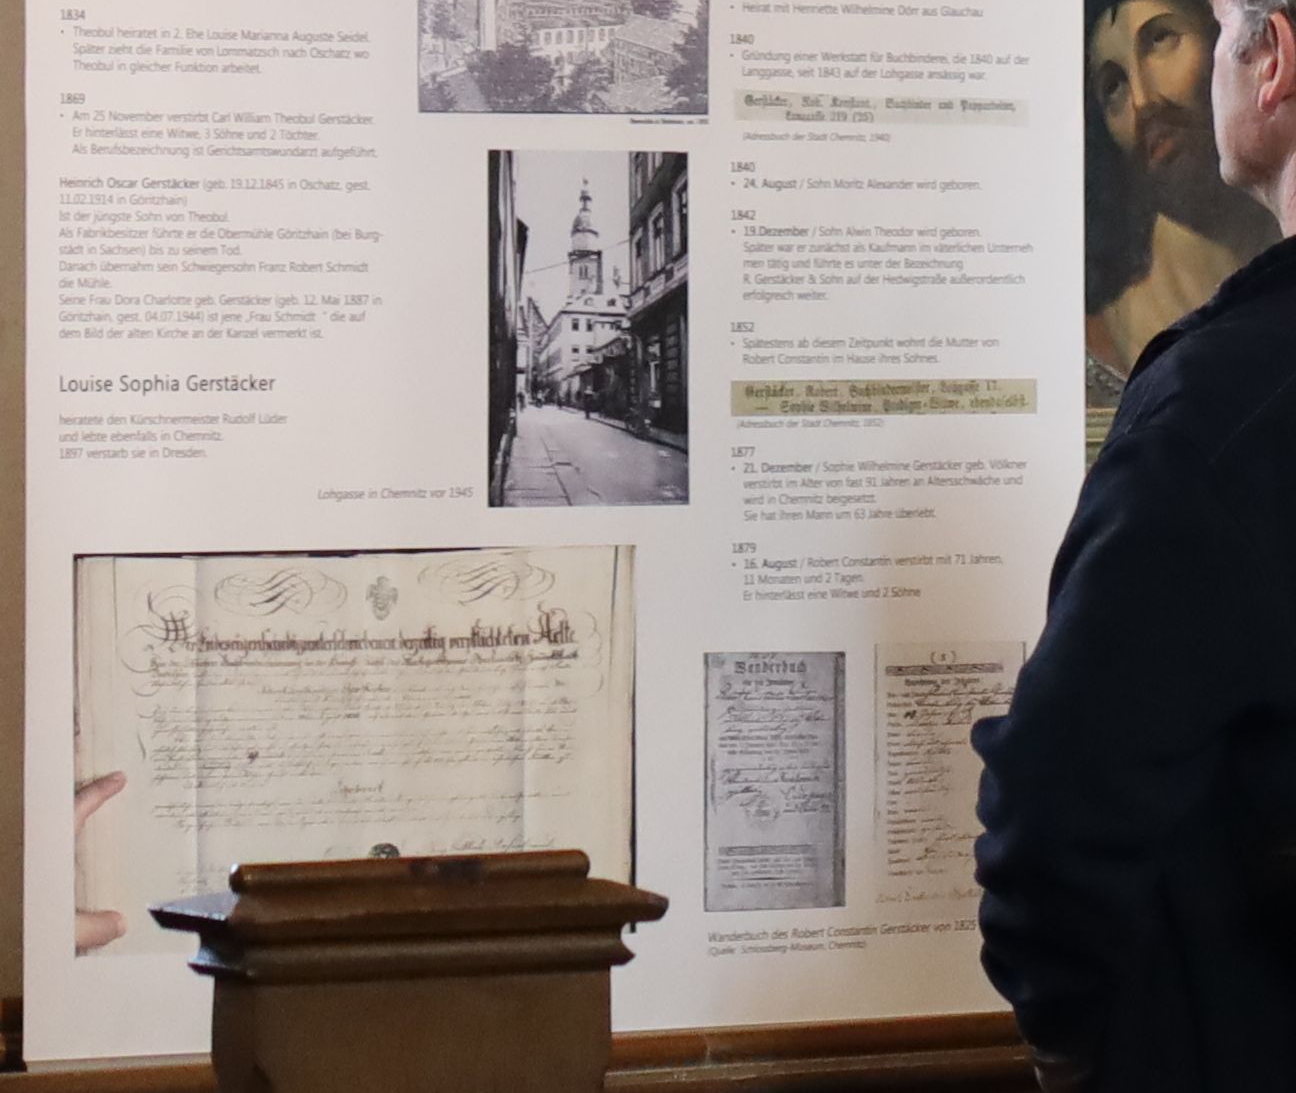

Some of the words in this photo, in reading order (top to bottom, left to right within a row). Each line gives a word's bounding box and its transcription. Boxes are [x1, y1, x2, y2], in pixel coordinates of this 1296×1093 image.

[58, 374, 113, 392] Louise
[119, 374, 180, 397] Sophia
[185, 373, 275, 392] Gerstäcker
